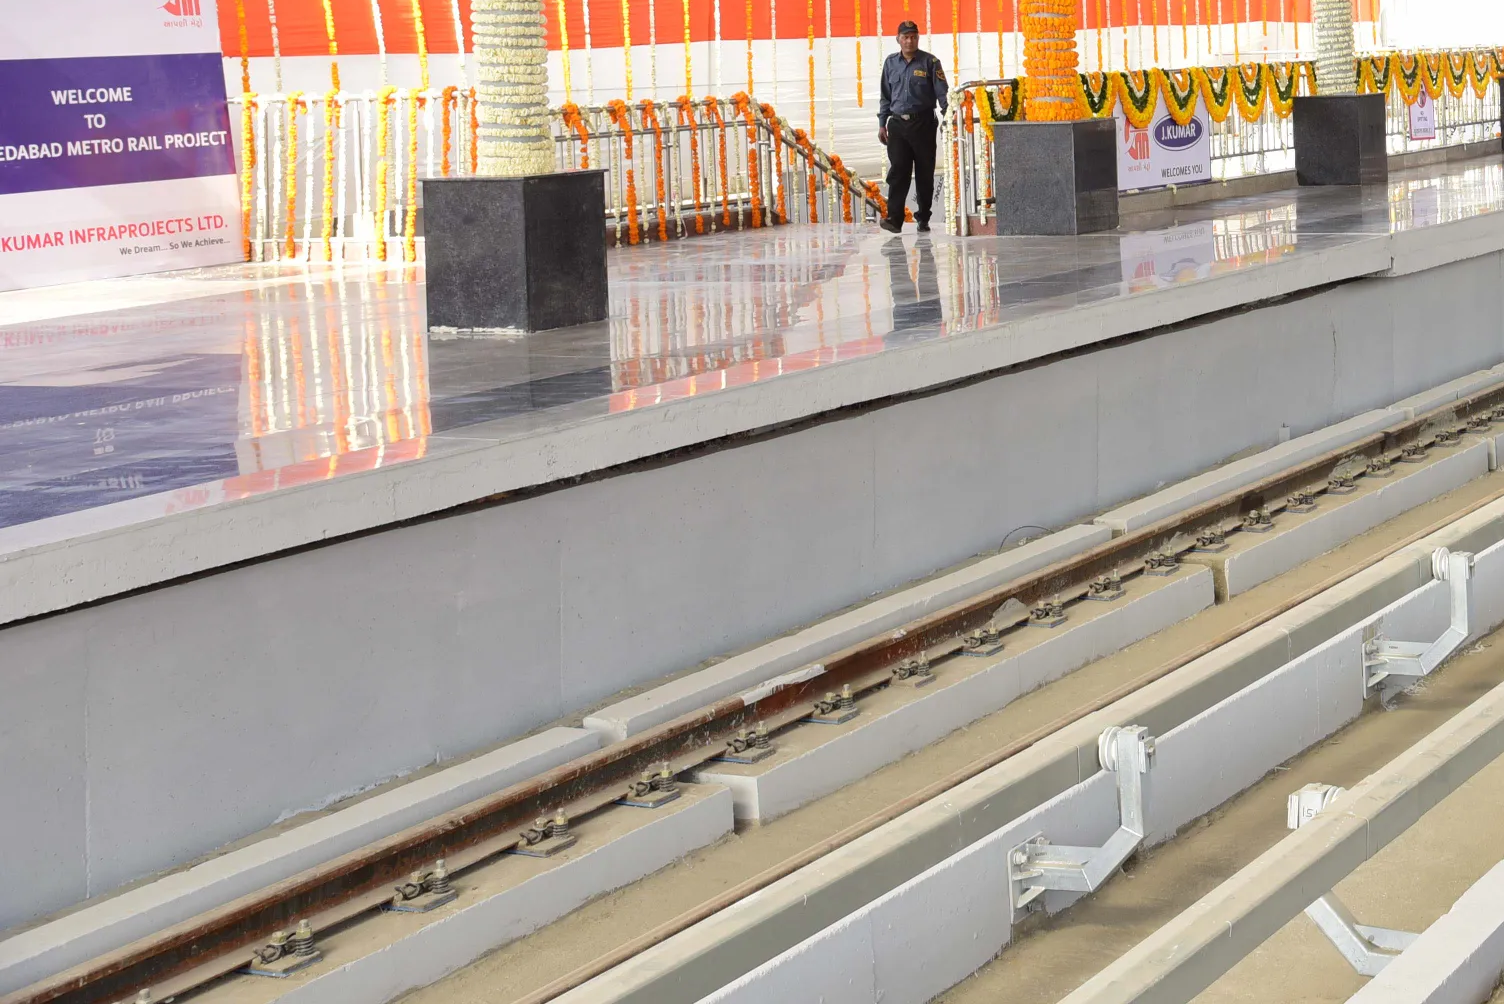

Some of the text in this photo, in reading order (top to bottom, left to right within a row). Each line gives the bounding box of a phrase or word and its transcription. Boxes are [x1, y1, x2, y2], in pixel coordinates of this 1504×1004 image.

[51, 87, 133, 105] WELCOME
[83, 114, 106, 129] TO
[1161, 123, 1197, 141] J.KUMAR
[66, 138, 124, 156] METRO
[127, 135, 162, 152] RAIL
[164, 131, 227, 149] PROJECT
[1161, 164, 1203, 178] WELCOMES YOU
[69, 218, 193, 245] INFRAPROJECTS
[197, 215, 228, 231] LTD.
[119, 247, 132, 255] We
[169, 242, 180, 250] So
